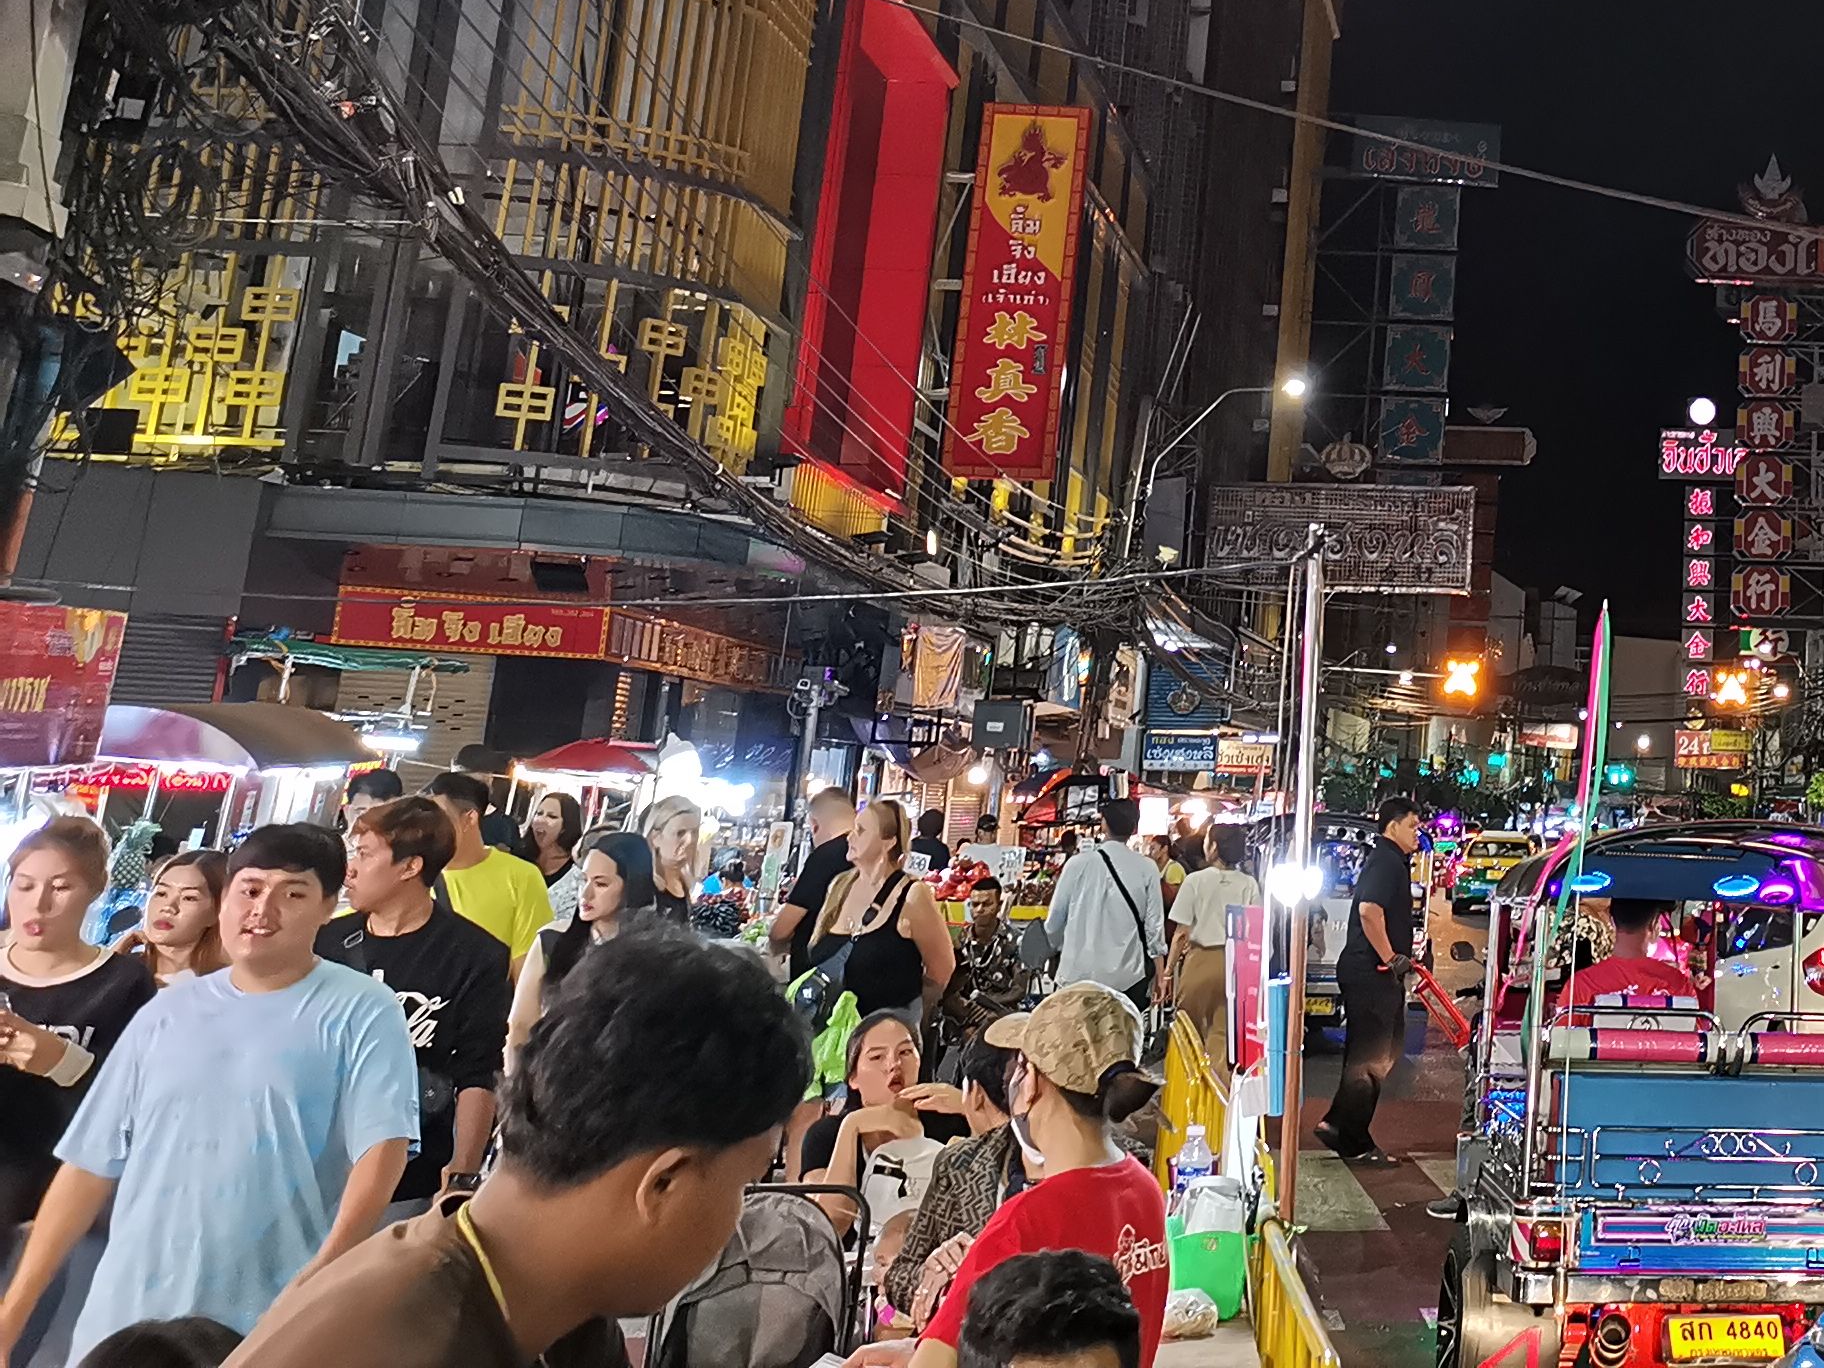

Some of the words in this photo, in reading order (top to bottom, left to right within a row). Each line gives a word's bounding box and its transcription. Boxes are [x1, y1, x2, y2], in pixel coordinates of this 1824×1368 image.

[964, 310, 1048, 456] 林真香
[1679, 1321, 1713, 1342] สก
[1726, 1320, 1779, 1341] 4840
